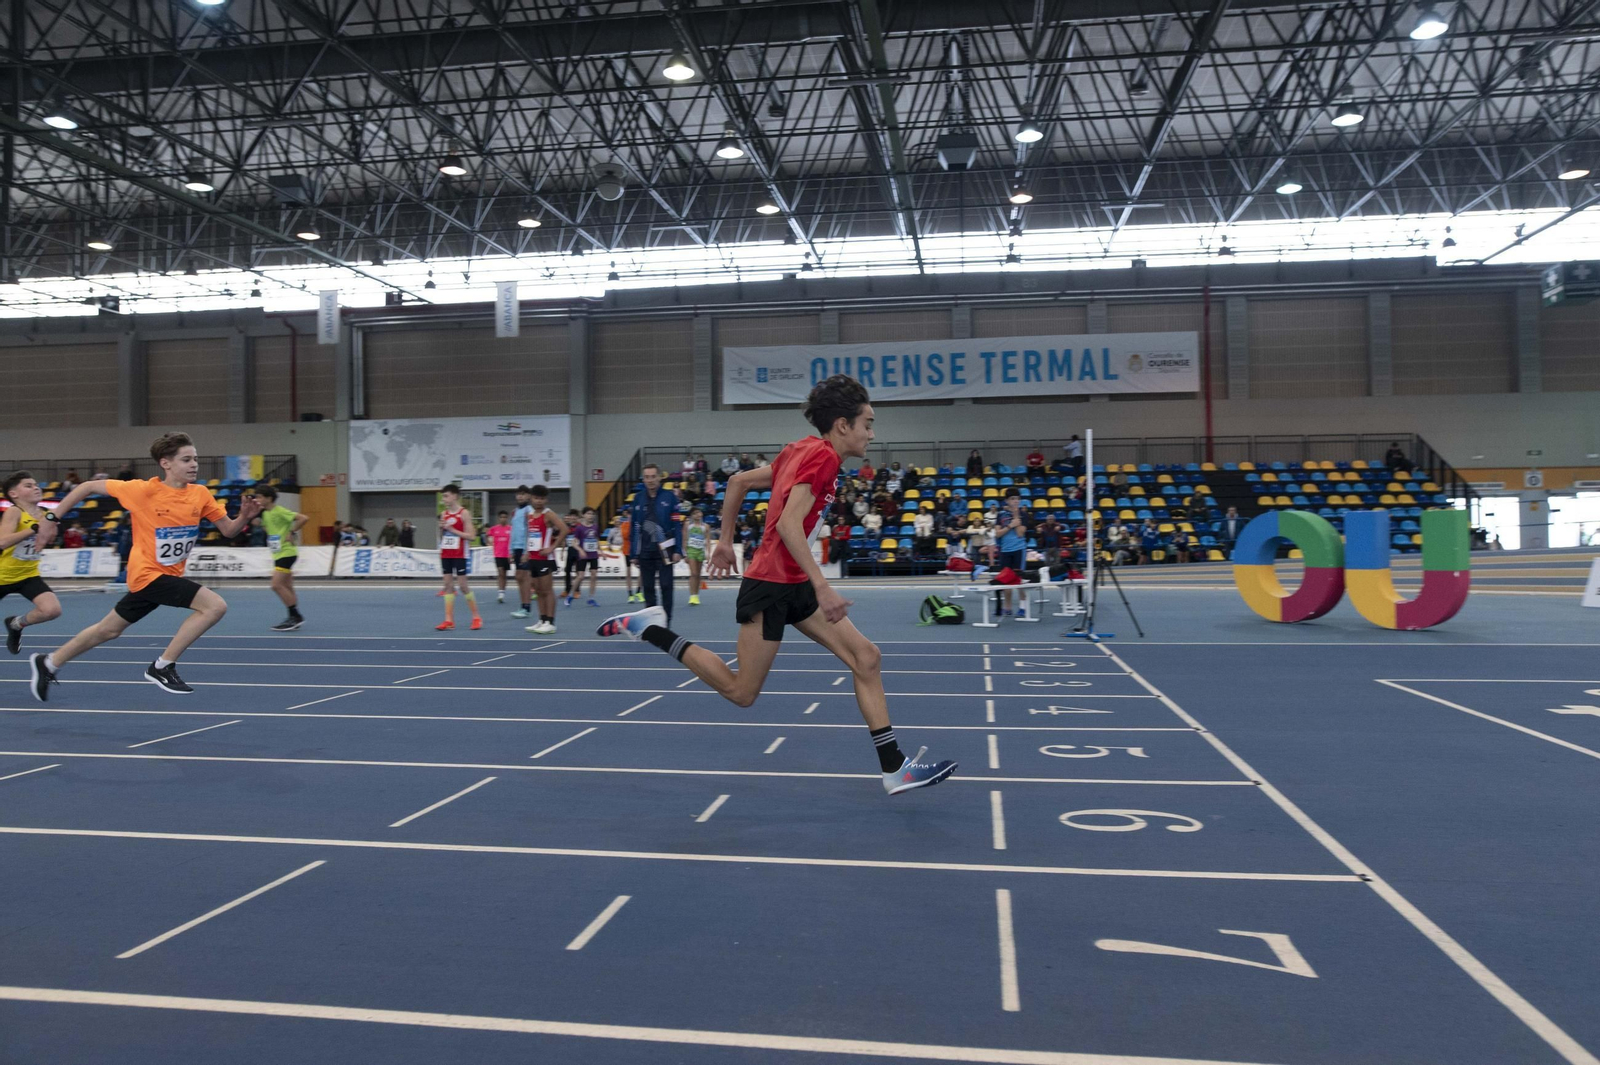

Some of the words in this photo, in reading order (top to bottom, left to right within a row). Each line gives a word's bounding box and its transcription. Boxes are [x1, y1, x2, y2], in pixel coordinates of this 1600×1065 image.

[810, 352, 966, 388] OURENSE
[979, 348, 1120, 384] TERMAL
[1147, 359, 1191, 367] OURENSE
[160, 540, 194, 558] 280
[1028, 705, 1114, 715] 4
[1039, 744, 1149, 759] 5
[1059, 808, 1204, 833] 6
[1095, 928, 1319, 978] 7
